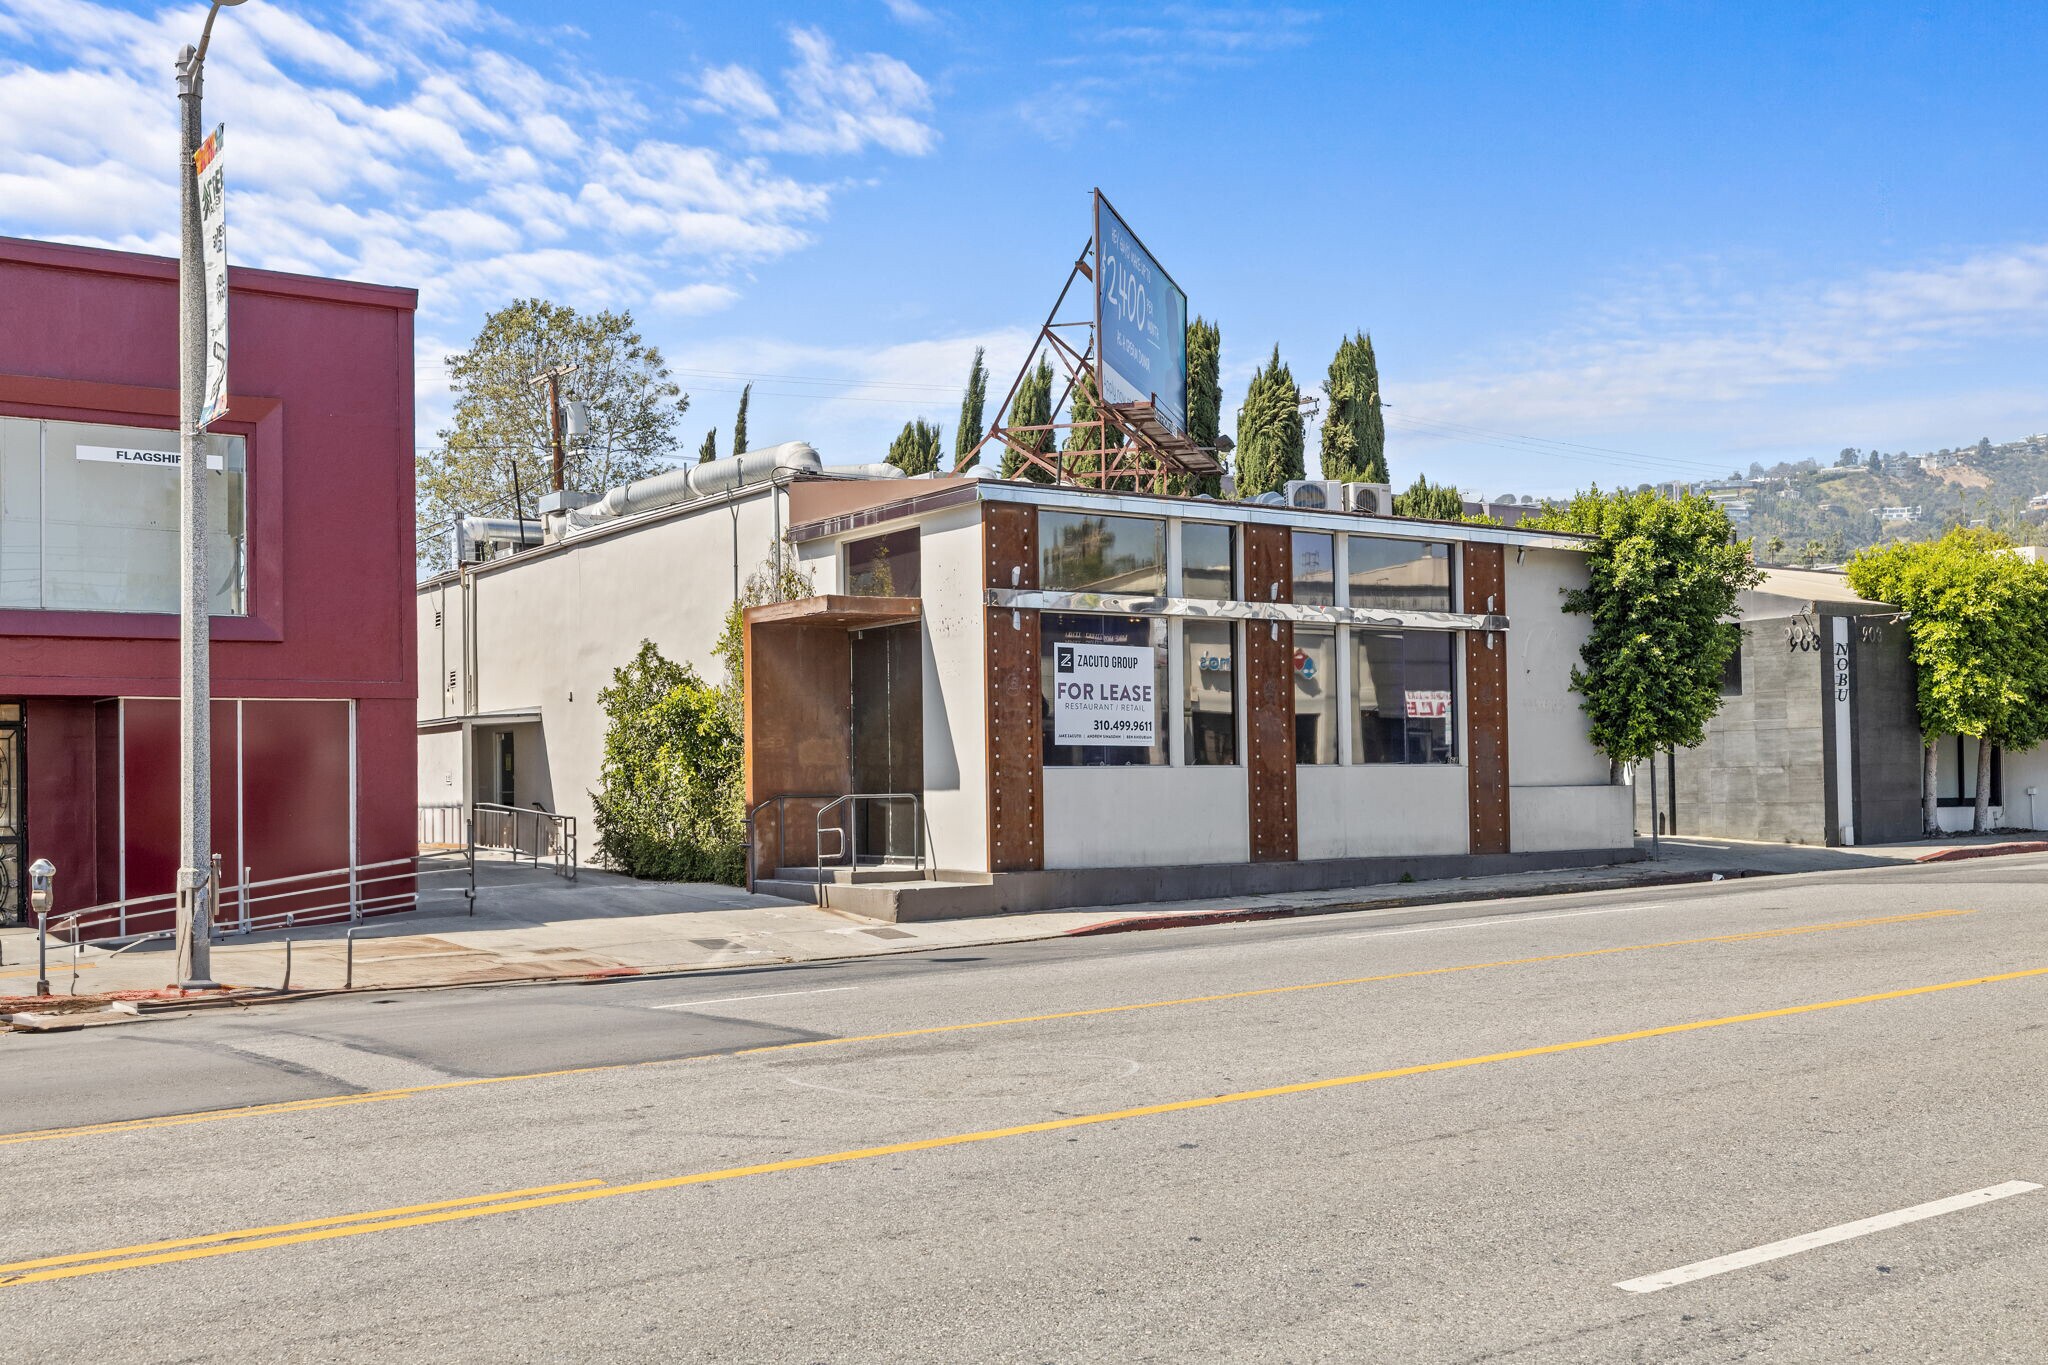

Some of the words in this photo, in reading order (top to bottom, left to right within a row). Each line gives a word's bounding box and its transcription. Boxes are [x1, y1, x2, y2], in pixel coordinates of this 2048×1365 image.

[1101, 241, 1146, 331] $2,400
[1077, 655, 1109, 668] ZACUTO
[1111, 656, 1138, 669] GROUP
[1835, 642, 1849, 702] NOBU
[1058, 682, 1094, 700] FOR
[1100, 684, 1152, 702] LEASE
[1065, 702, 1114, 711] RESTAURANT
[1121, 704, 1145, 712] RETAIL
[1093, 720, 1152, 732] 310.499.9611
